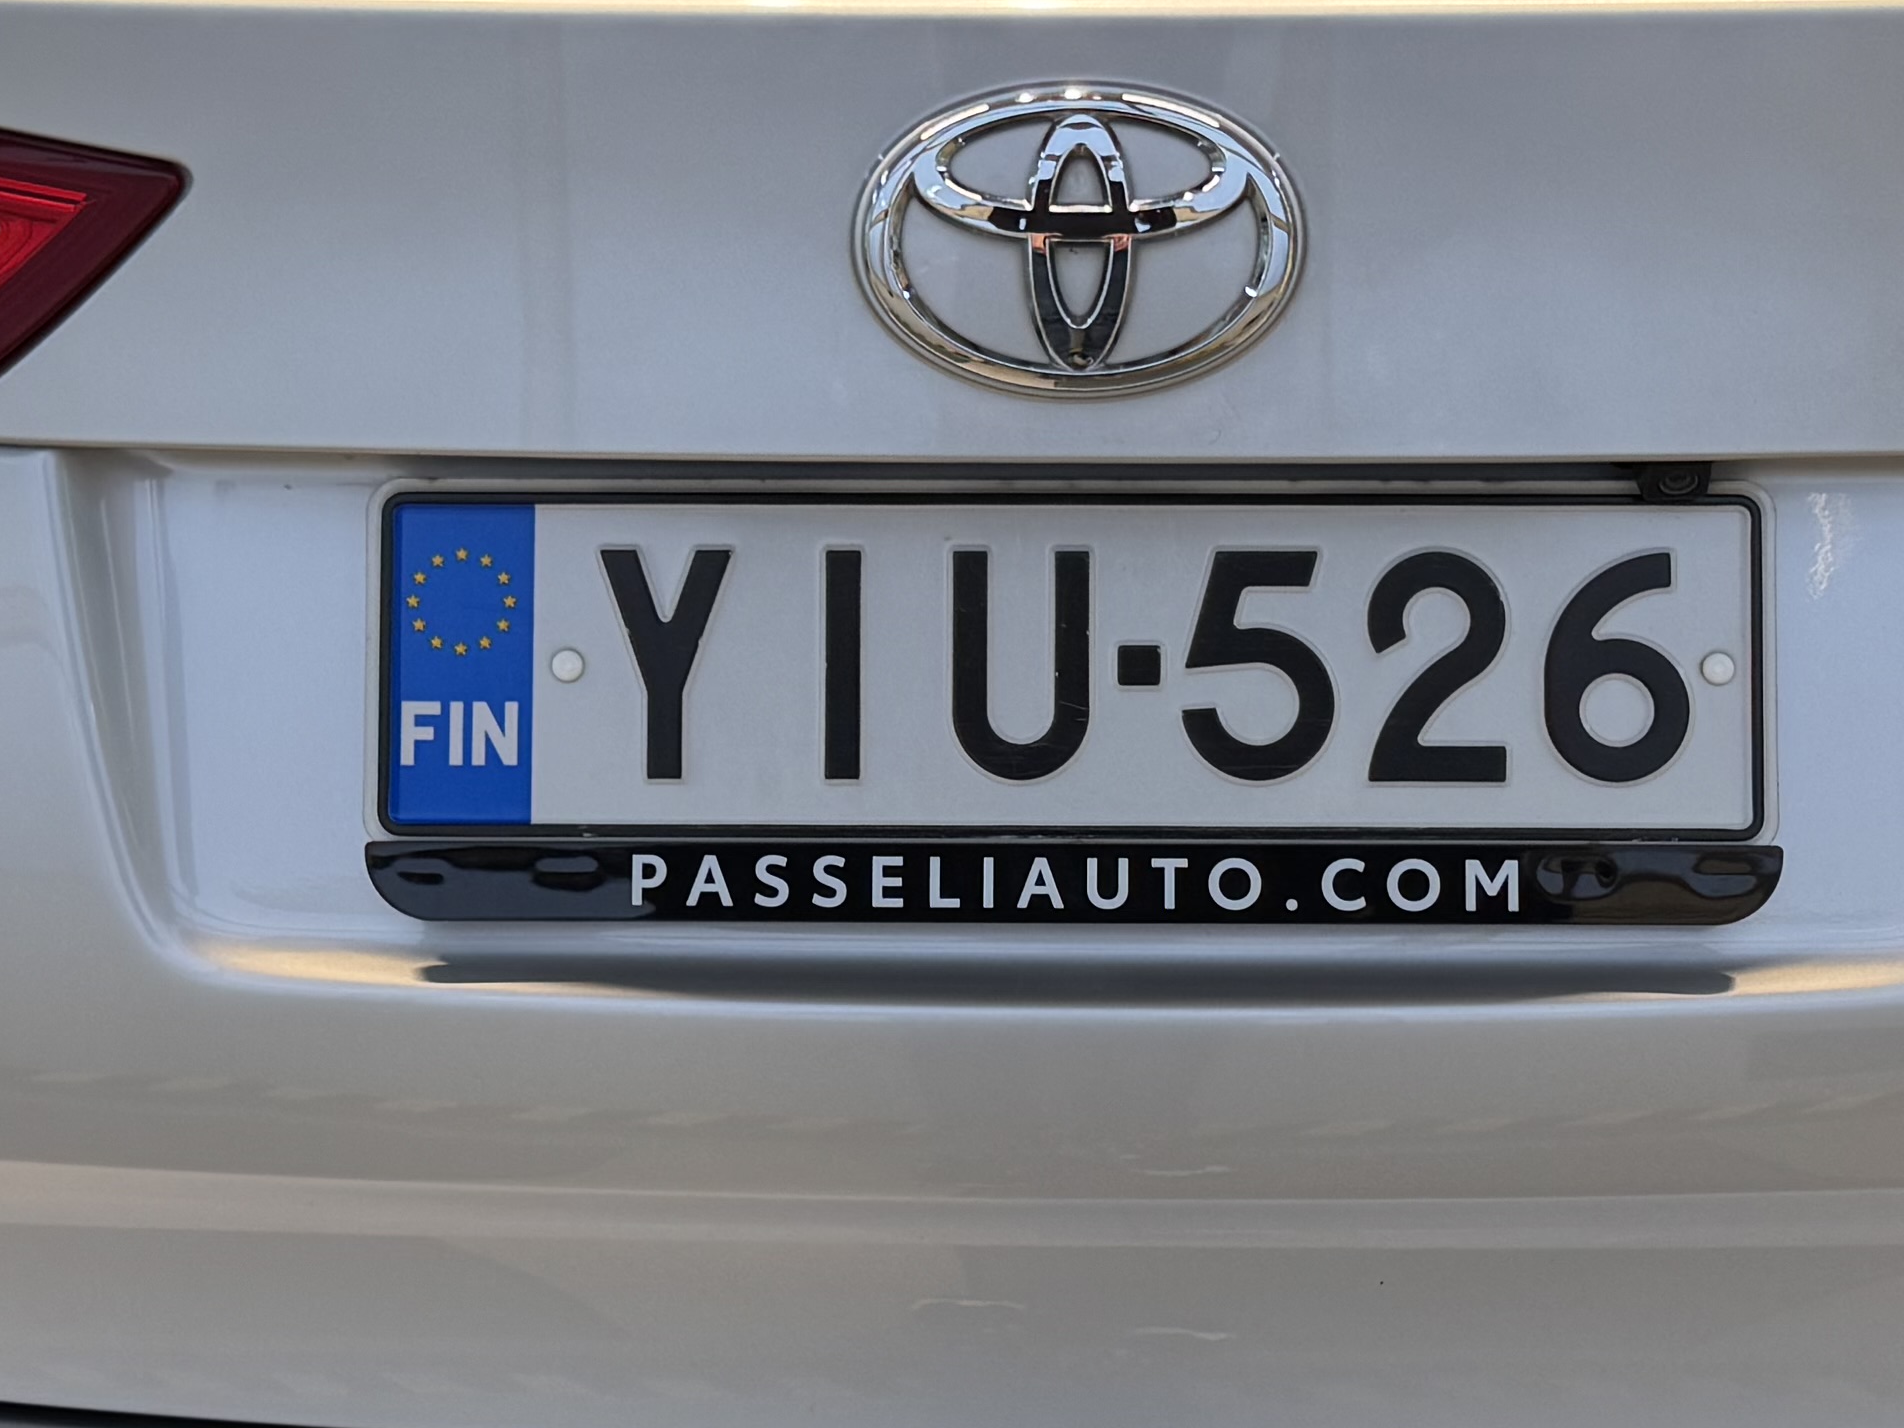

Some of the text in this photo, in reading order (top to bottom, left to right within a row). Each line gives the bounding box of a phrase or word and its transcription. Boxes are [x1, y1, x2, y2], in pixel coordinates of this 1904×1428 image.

[600, 548, 1692, 784] YIU-526
[400, 700, 519, 766] FIN
[630, 853, 1522, 913] PASSELIAUTO.COM
